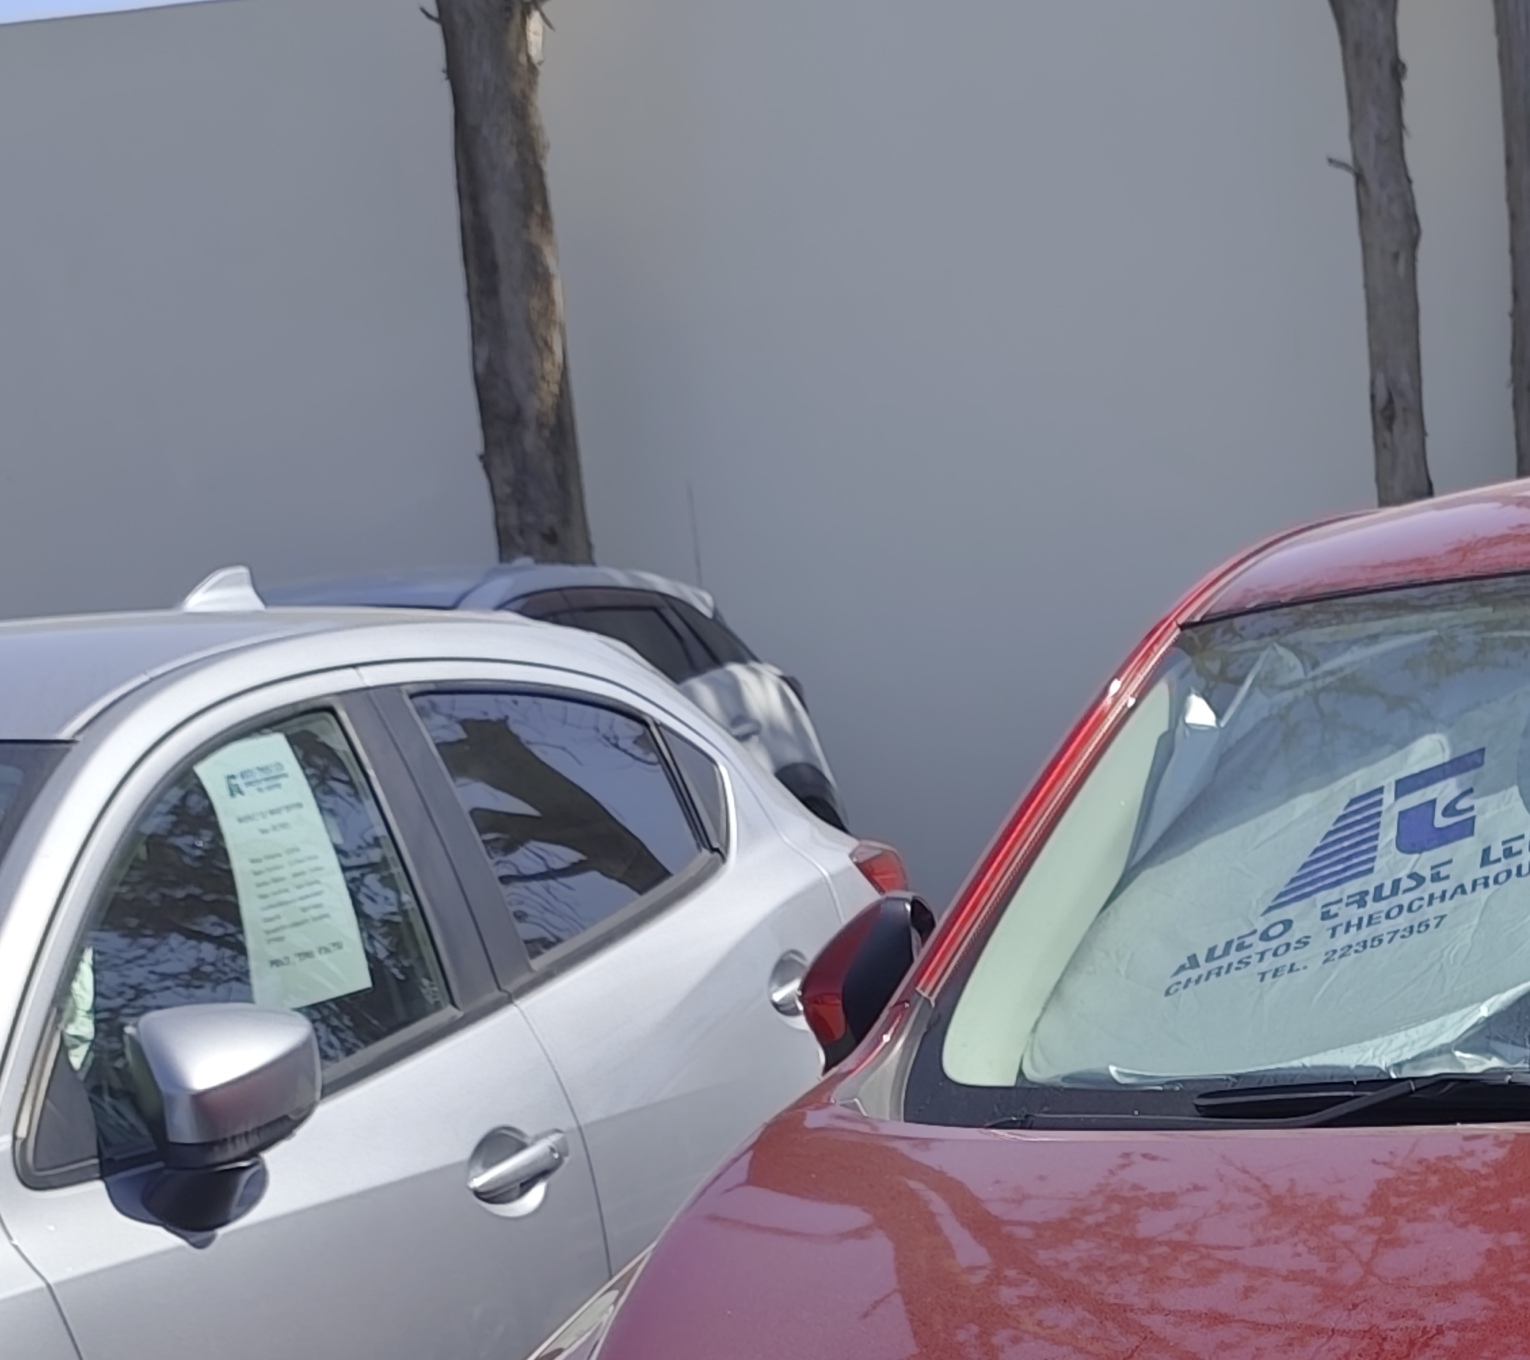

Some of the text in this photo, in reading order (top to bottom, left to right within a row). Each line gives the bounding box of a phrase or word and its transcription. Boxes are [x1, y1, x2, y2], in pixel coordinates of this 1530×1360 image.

[1170, 918, 1294, 978] AUTO
[1320, 859, 1453, 921] TRUST
[1257, 914, 1448, 983] TEL. 22357357
[1164, 934, 1311, 998] CHRISTOS
